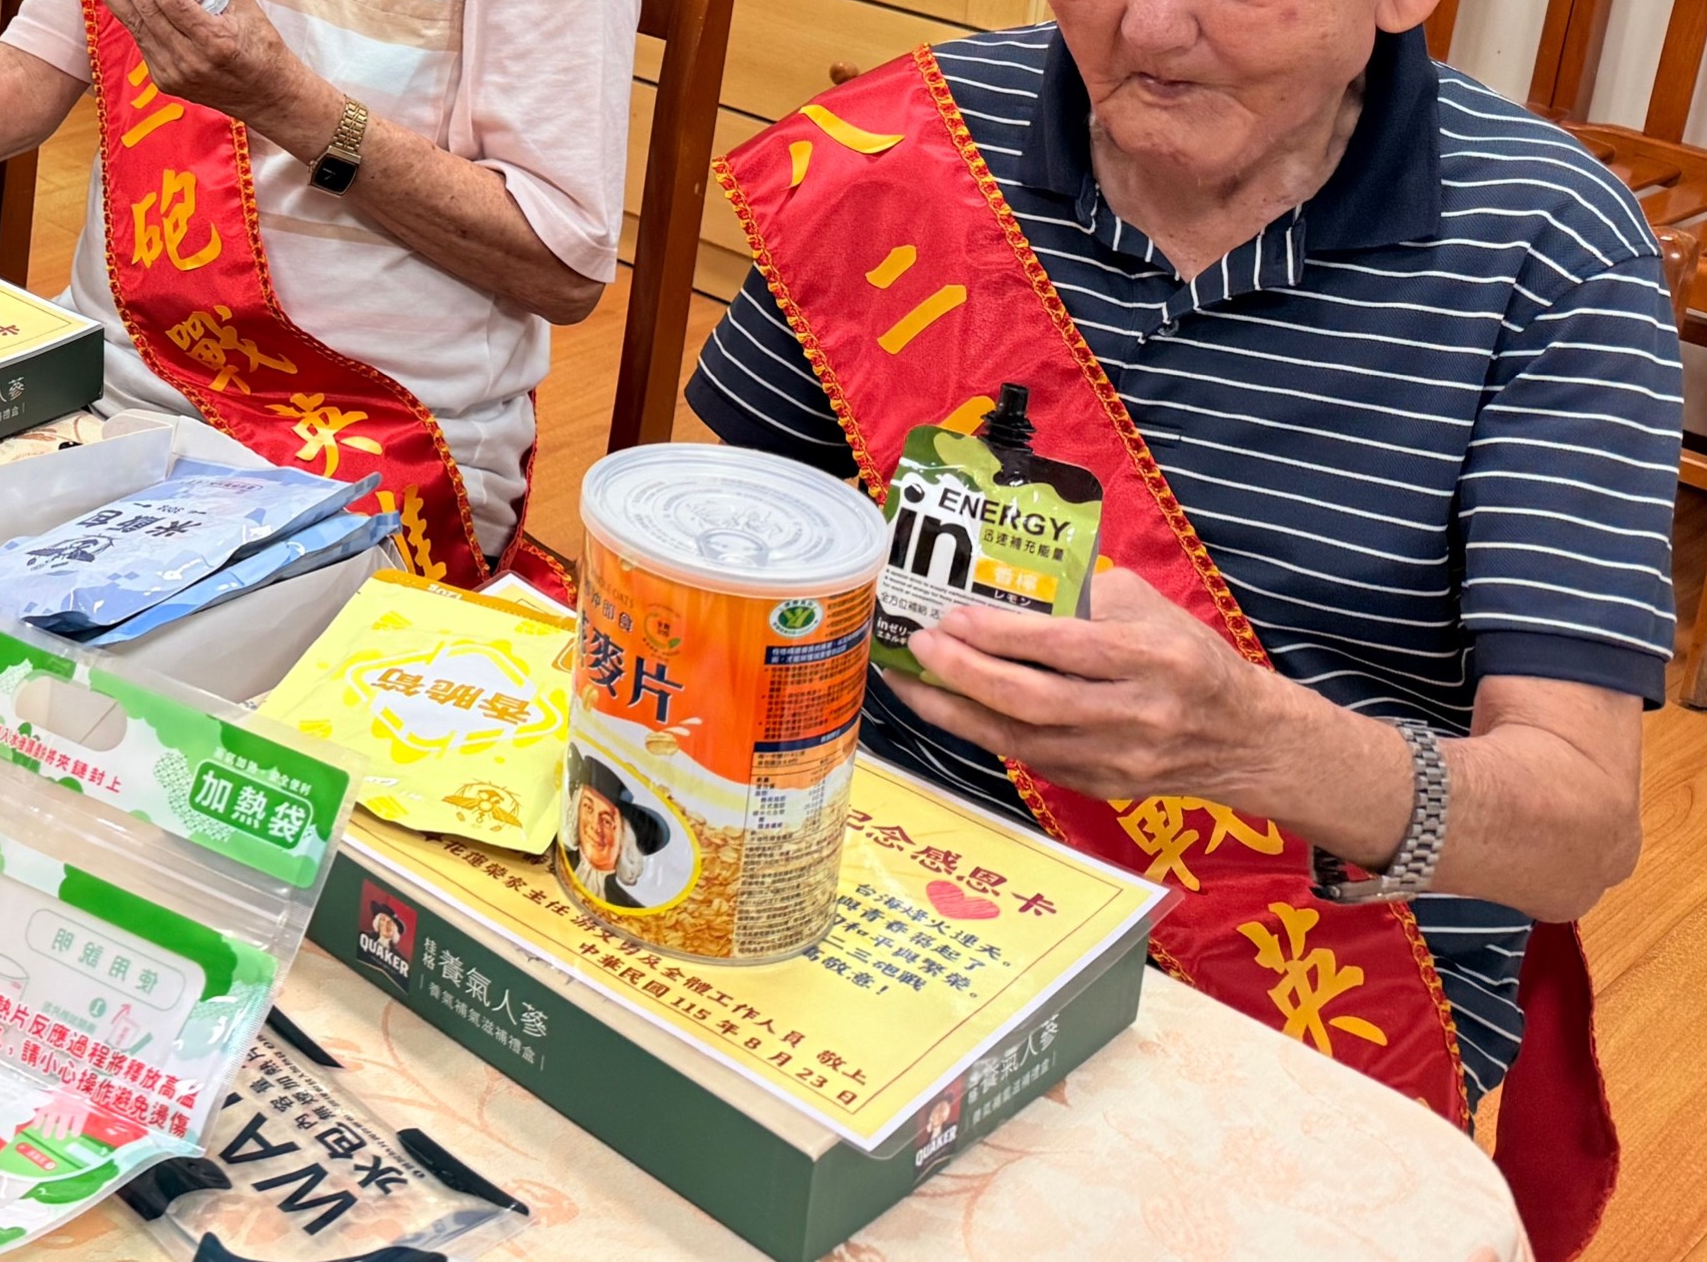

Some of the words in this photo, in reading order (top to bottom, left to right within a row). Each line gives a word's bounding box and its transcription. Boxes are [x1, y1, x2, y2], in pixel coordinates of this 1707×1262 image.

[888, 483, 973, 591] in
[938, 488, 1071, 542] ENERGY
[983, 529, 1065, 562] 迅速補充能量
[880, 592, 928, 617] 全方位補給
[994, 590, 1032, 607] レモン
[371, 668, 531, 726] 香脆筍
[194, 770, 308, 843] 加熱袋
[422, 936, 438, 971] 桂格
[855, 883, 1012, 968] 台海烽火連天。
[359, 932, 410, 978] QUAKER
[822, 934, 928, 992] 二三砲戰
[438, 949, 549, 1038] 養氣人蔘
[428, 981, 537, 1065] 養氣補氣滋補禮盒
[578, 942, 671, 999] 中華民國
[670, 995, 712, 1021] 115
[716, 1019, 739, 1036] 年
[743, 1036, 762, 1050] 8
[768, 1050, 793, 1068] 月
[795, 1066, 829, 1089] 23
[836, 1089, 859, 1106] 日
[815, 1049, 869, 1087] 敬上
[219, 1092, 359, 1236] WA
[315, 1122, 409, 1196] 水包
[915, 1124, 958, 1167] QUAKER
